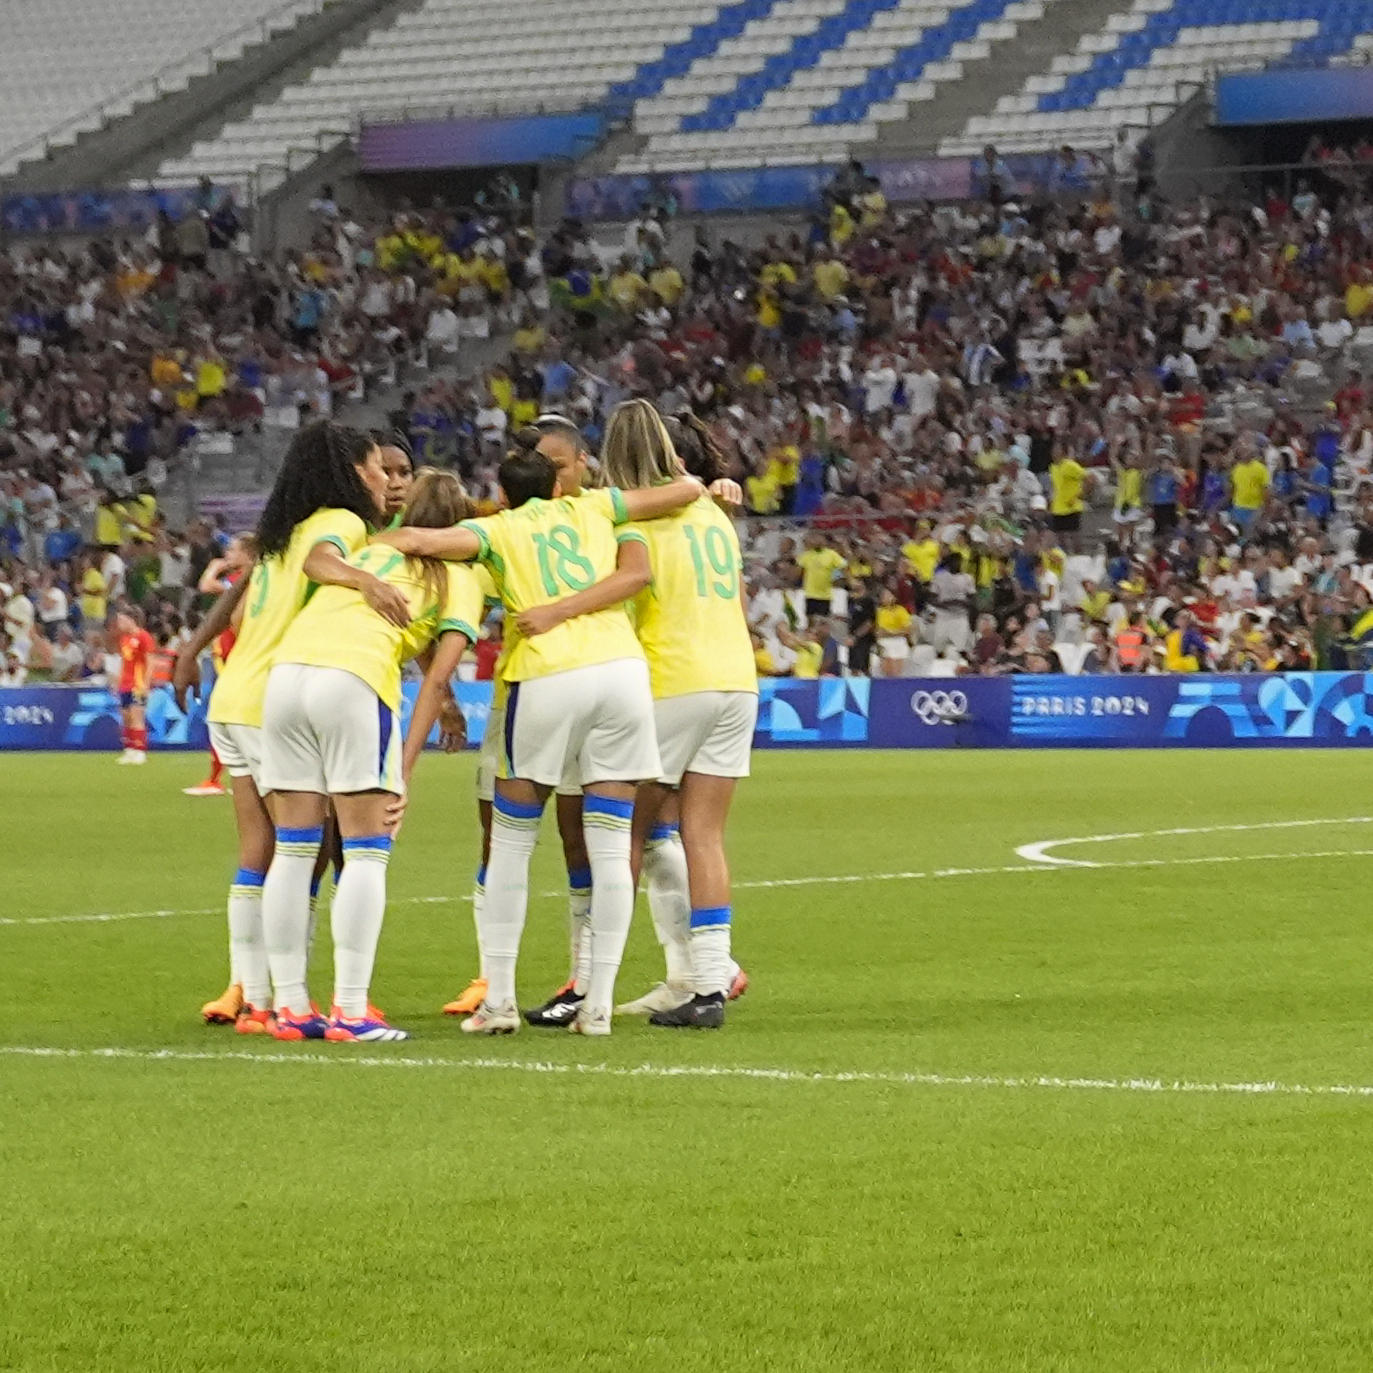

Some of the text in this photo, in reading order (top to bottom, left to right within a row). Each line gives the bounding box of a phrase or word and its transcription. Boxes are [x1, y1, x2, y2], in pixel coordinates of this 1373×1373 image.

[531, 524, 596, 598] 18
[682, 523, 739, 600] 19
[1021, 695, 1150, 717] PARIS 2024
